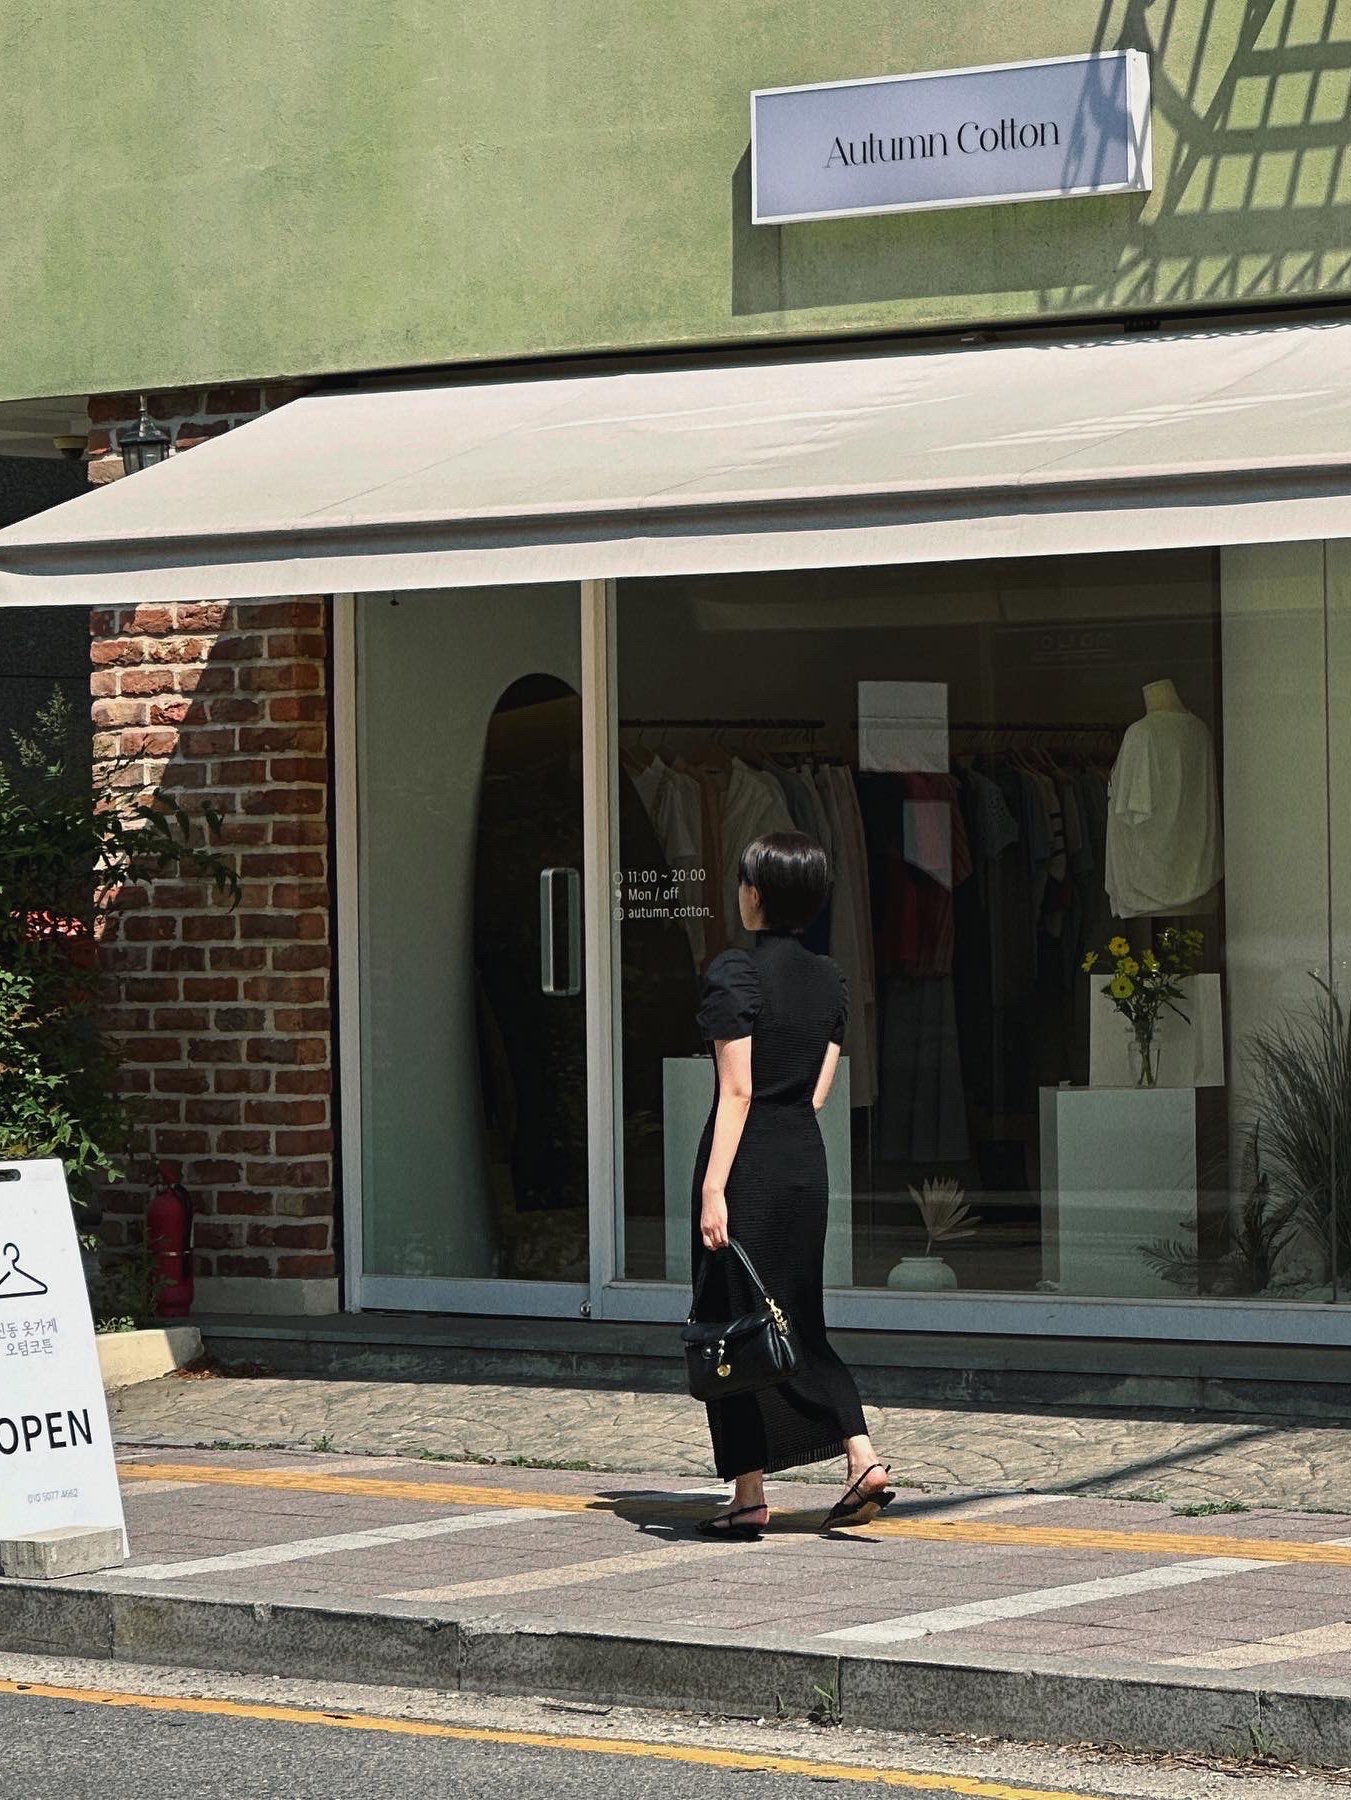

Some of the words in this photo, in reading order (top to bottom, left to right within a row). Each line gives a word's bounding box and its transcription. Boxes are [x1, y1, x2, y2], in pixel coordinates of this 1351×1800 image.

[824, 132, 948, 169] Autumn
[957, 118, 1061, 154] Cotton
[628, 870, 657, 883] 11:00
[671, 868, 706, 882] 20:00
[628, 888, 652, 901] Mon
[663, 886, 680, 900] off
[628, 905, 715, 919] autumn_cotton_
[22, 1317, 58, 1337] 옷가게
[6, 1338, 53, 1357] 오텀코튼
[0, 1408, 92, 1455] OPEN
